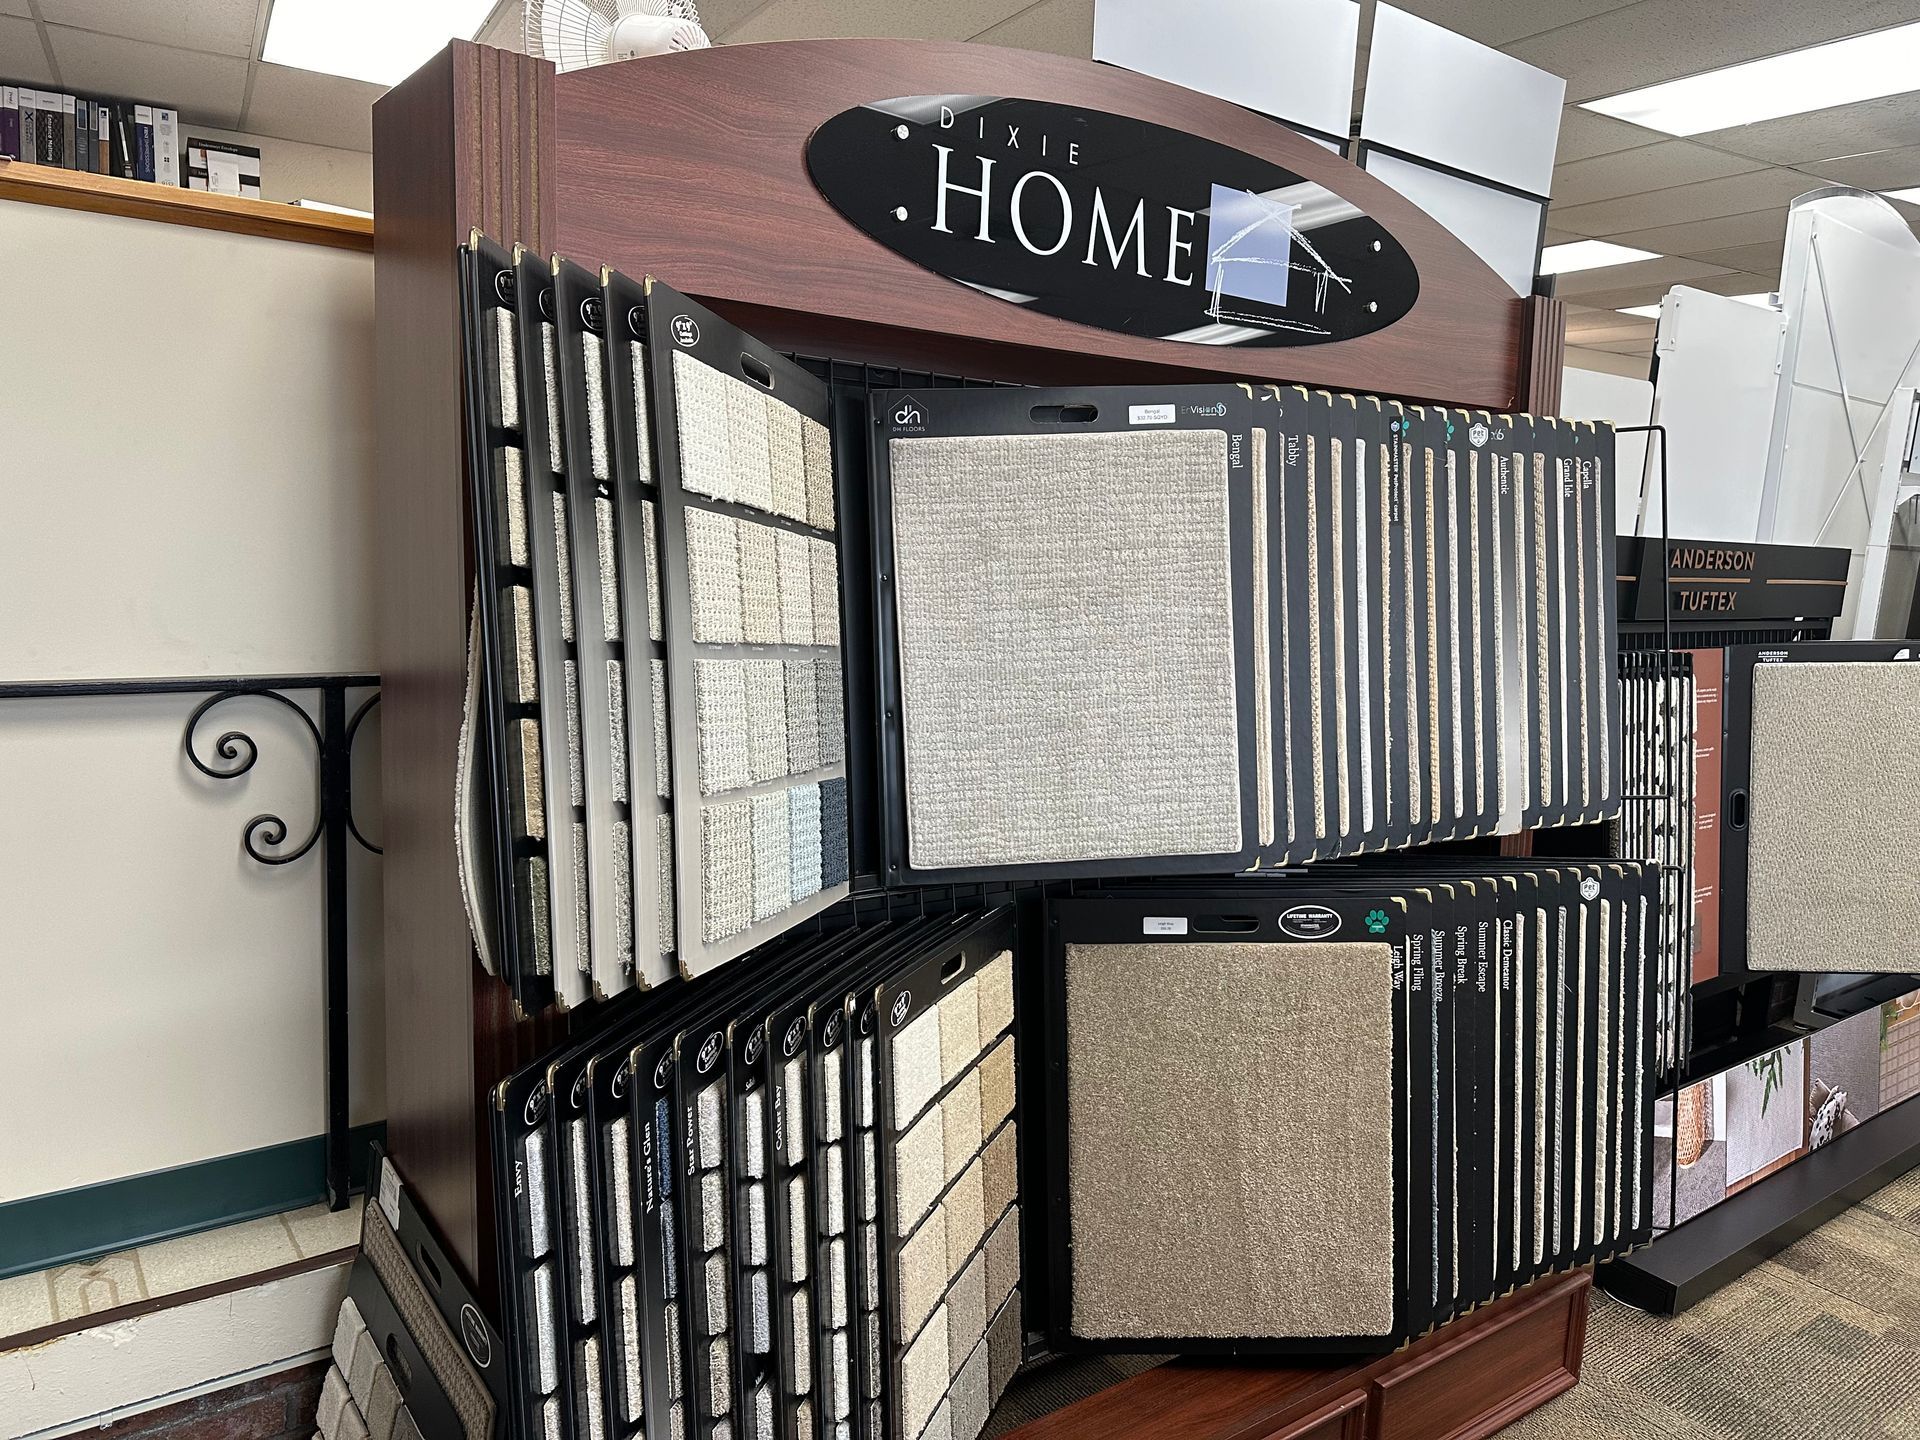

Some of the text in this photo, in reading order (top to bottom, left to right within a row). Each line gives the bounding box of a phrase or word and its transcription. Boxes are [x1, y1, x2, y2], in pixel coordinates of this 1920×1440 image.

[940, 105, 1079, 165] DIXIE
[931, 144, 1195, 286] HOME
[1229, 433, 1244, 469] Bengal
[1285, 434, 1300, 467] Tabby
[1500, 455, 1510, 495] Authentic
[1563, 458, 1574, 498] Grand Isle
[1580, 460, 1592, 489] Capella
[1670, 548, 1756, 571] ANDERSON
[1680, 591, 1737, 611] TUFTEX
[1391, 945, 1404, 990] Leigh Way
[1410, 934, 1425, 991] Spring Fling
[1435, 930, 1446, 1002] Summer Breeze
[1455, 926, 1468, 984] Spring Break
[1476, 921, 1489, 992] Summer Escape
[1502, 920, 1513, 991] Classic Demeanor
[686, 1105, 696, 1176] Star Power
[774, 1085, 783, 1151] Colter Bay
[514, 1160, 523, 1198] Envy
[643, 1121, 654, 1214] Nature's Glen
